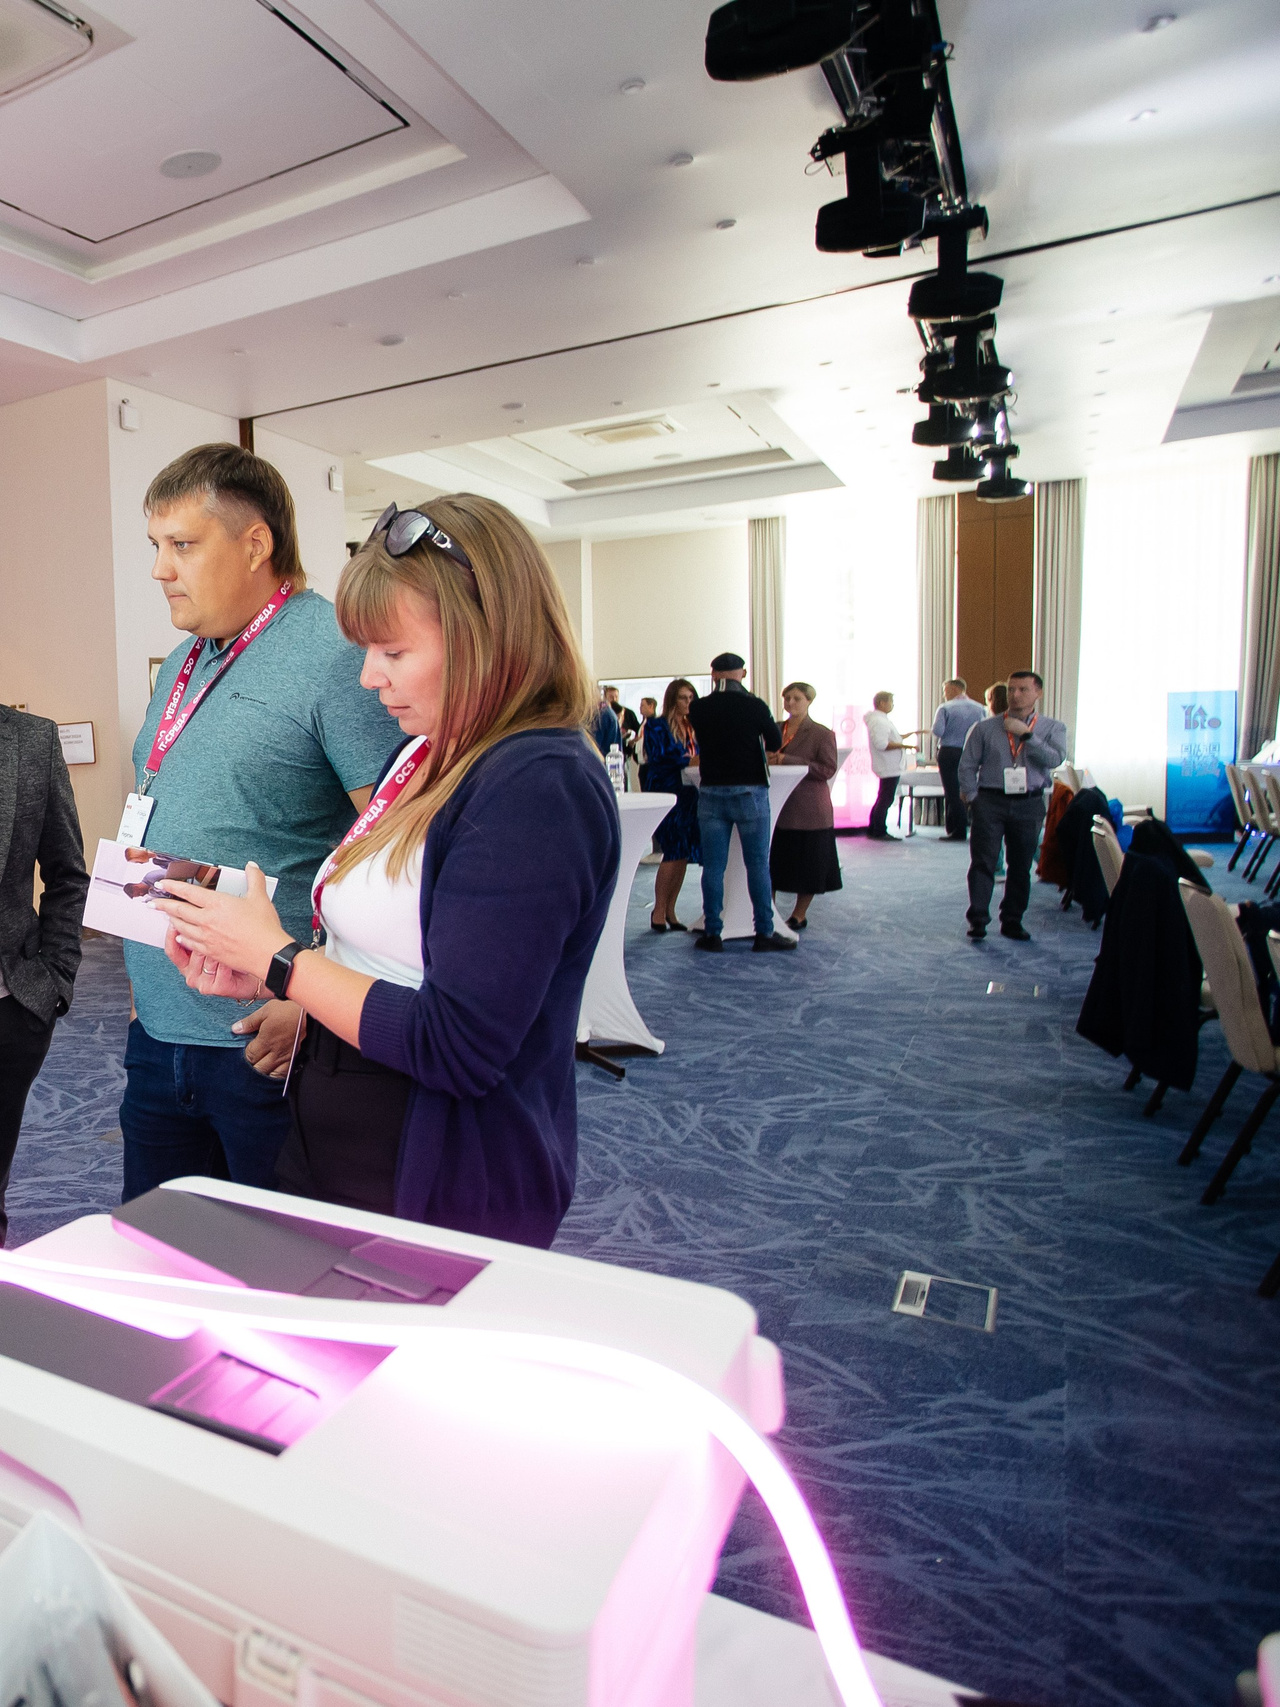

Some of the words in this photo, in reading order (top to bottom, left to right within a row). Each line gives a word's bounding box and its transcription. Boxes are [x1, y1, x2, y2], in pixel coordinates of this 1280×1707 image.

[242, 602, 277, 643] IT-СРЕДА
[280, 579, 291, 595] OCS
[183, 657, 195, 676] OCS
[164, 681, 185, 721] IT-СРЕДА
[158, 712, 189, 752] IT-СРЕДА
[344, 797, 388, 847] T-СРЕДА
[394, 760, 416, 785] OCS
